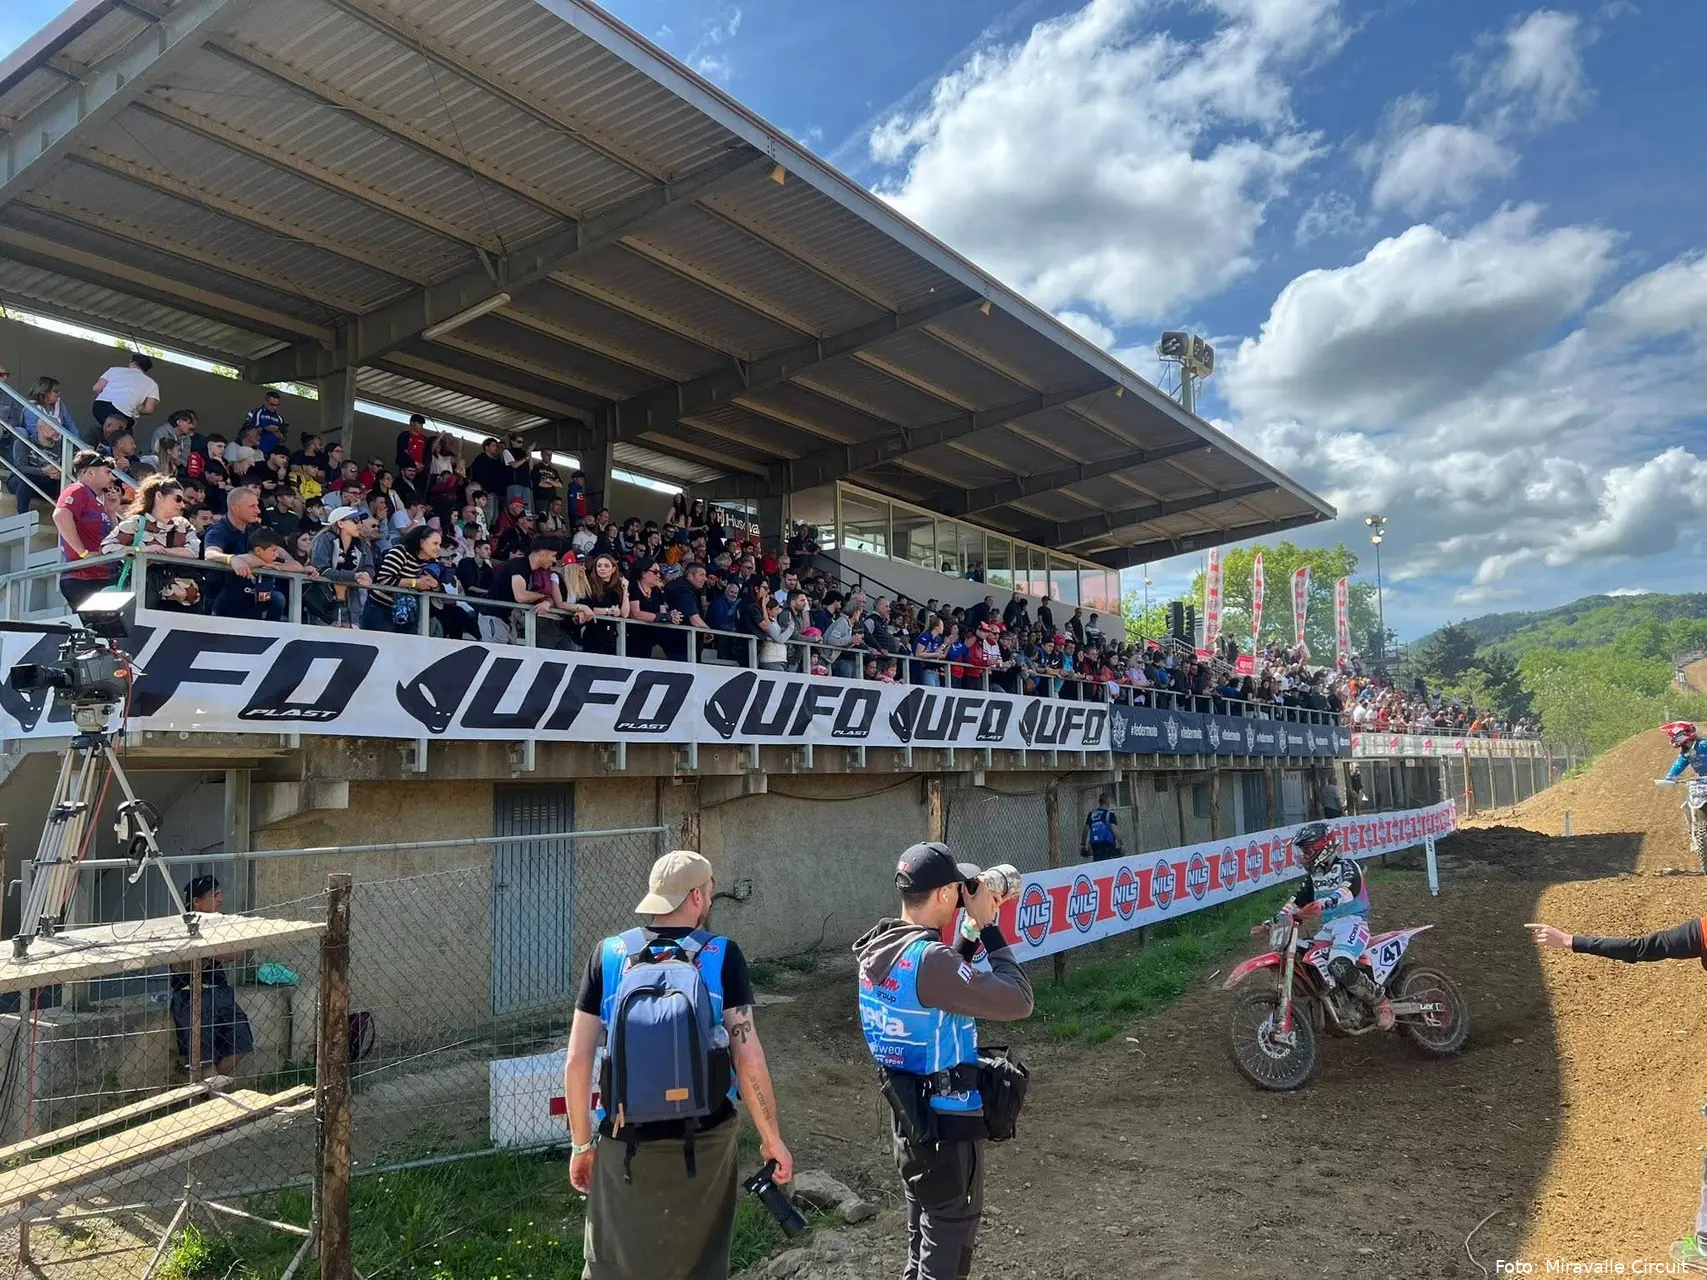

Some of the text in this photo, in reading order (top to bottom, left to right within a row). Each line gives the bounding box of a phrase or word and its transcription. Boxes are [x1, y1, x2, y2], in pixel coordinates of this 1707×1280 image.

[460, 656, 695, 733] UFO
[245, 707, 339, 721] PLAST
[740, 679, 882, 738] UFO
[913, 694, 1014, 742] UFO
[617, 722, 669, 731] PLAST
[833, 729, 870, 737] PLAST
[1034, 704, 1107, 745] UFO
[1246, 852, 1262, 871] NILS
[1270, 846, 1286, 864] NILS
[1187, 866, 1209, 887] NILS
[1220, 859, 1238, 879] NILS
[1113, 882, 1138, 906] NILS
[1152, 874, 1175, 897] NILS
[1069, 890, 1098, 917] NILS
[1018, 901, 1052, 931] NILS
[1383, 940, 1402, 963] 47
[876, 990, 897, 1004] group
